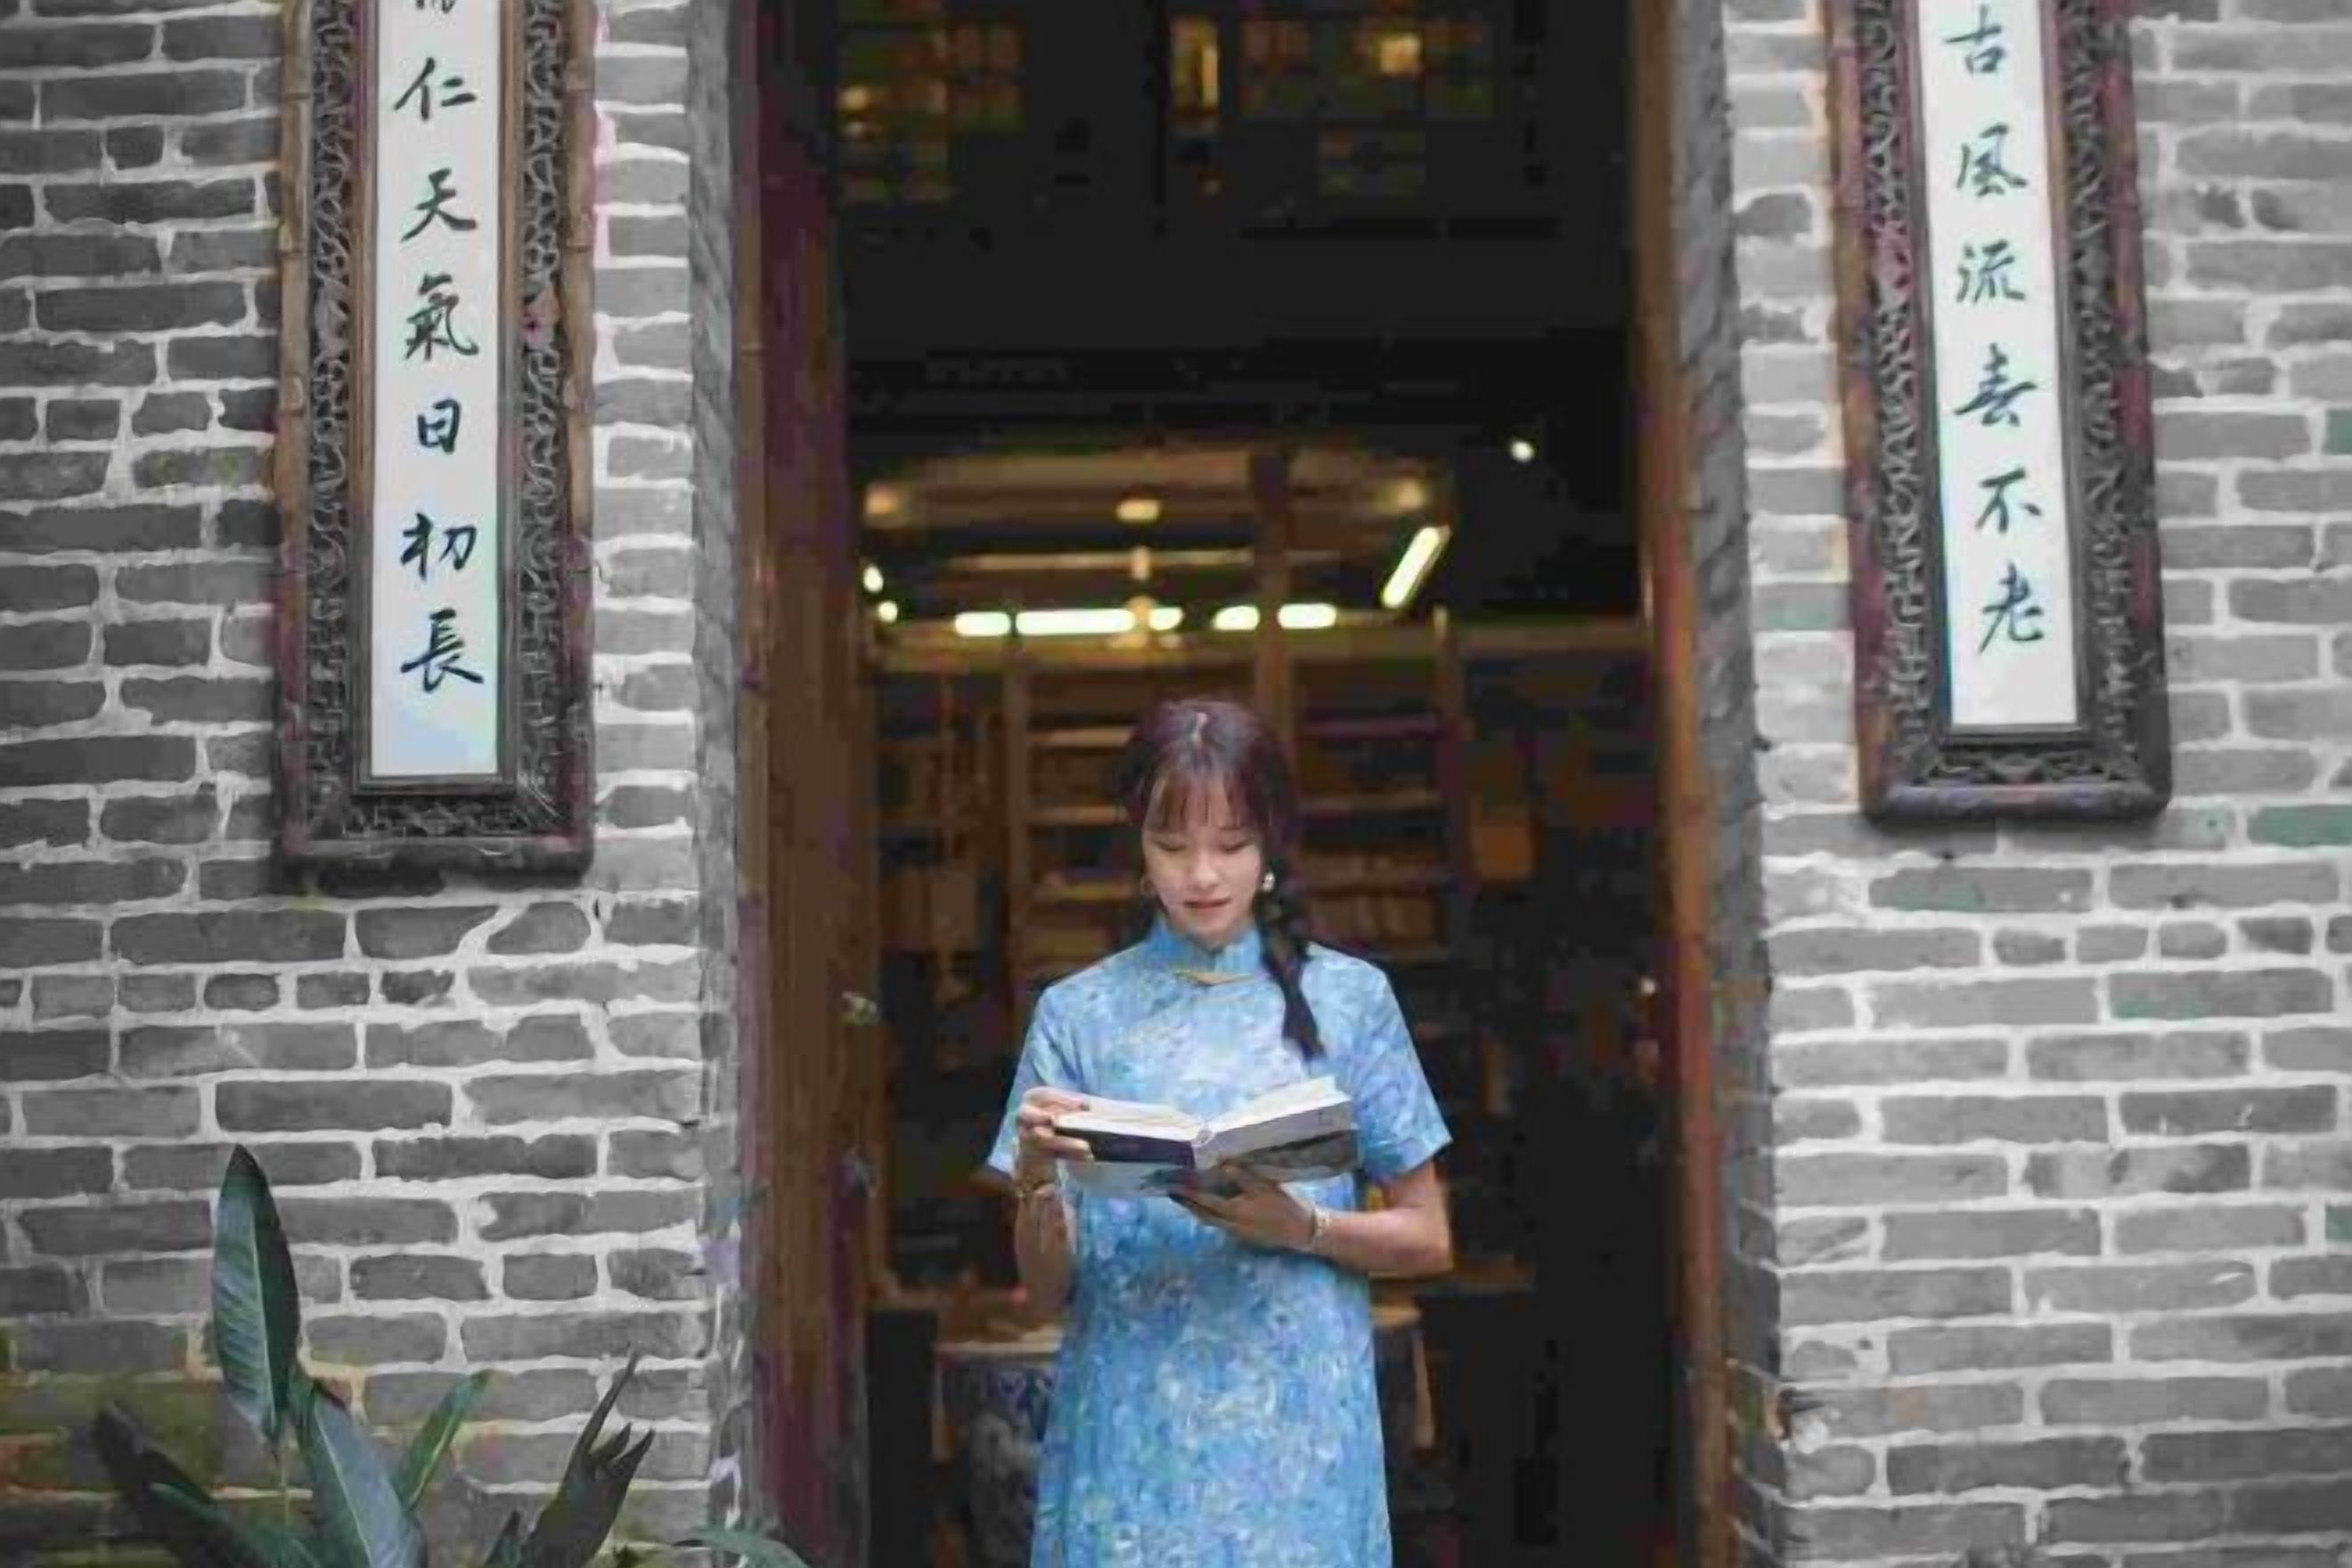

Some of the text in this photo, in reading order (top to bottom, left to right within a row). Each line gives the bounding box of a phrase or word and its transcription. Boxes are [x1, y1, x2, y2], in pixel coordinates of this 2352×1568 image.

[395, 0, 483, 694] 仁天氣日初長
